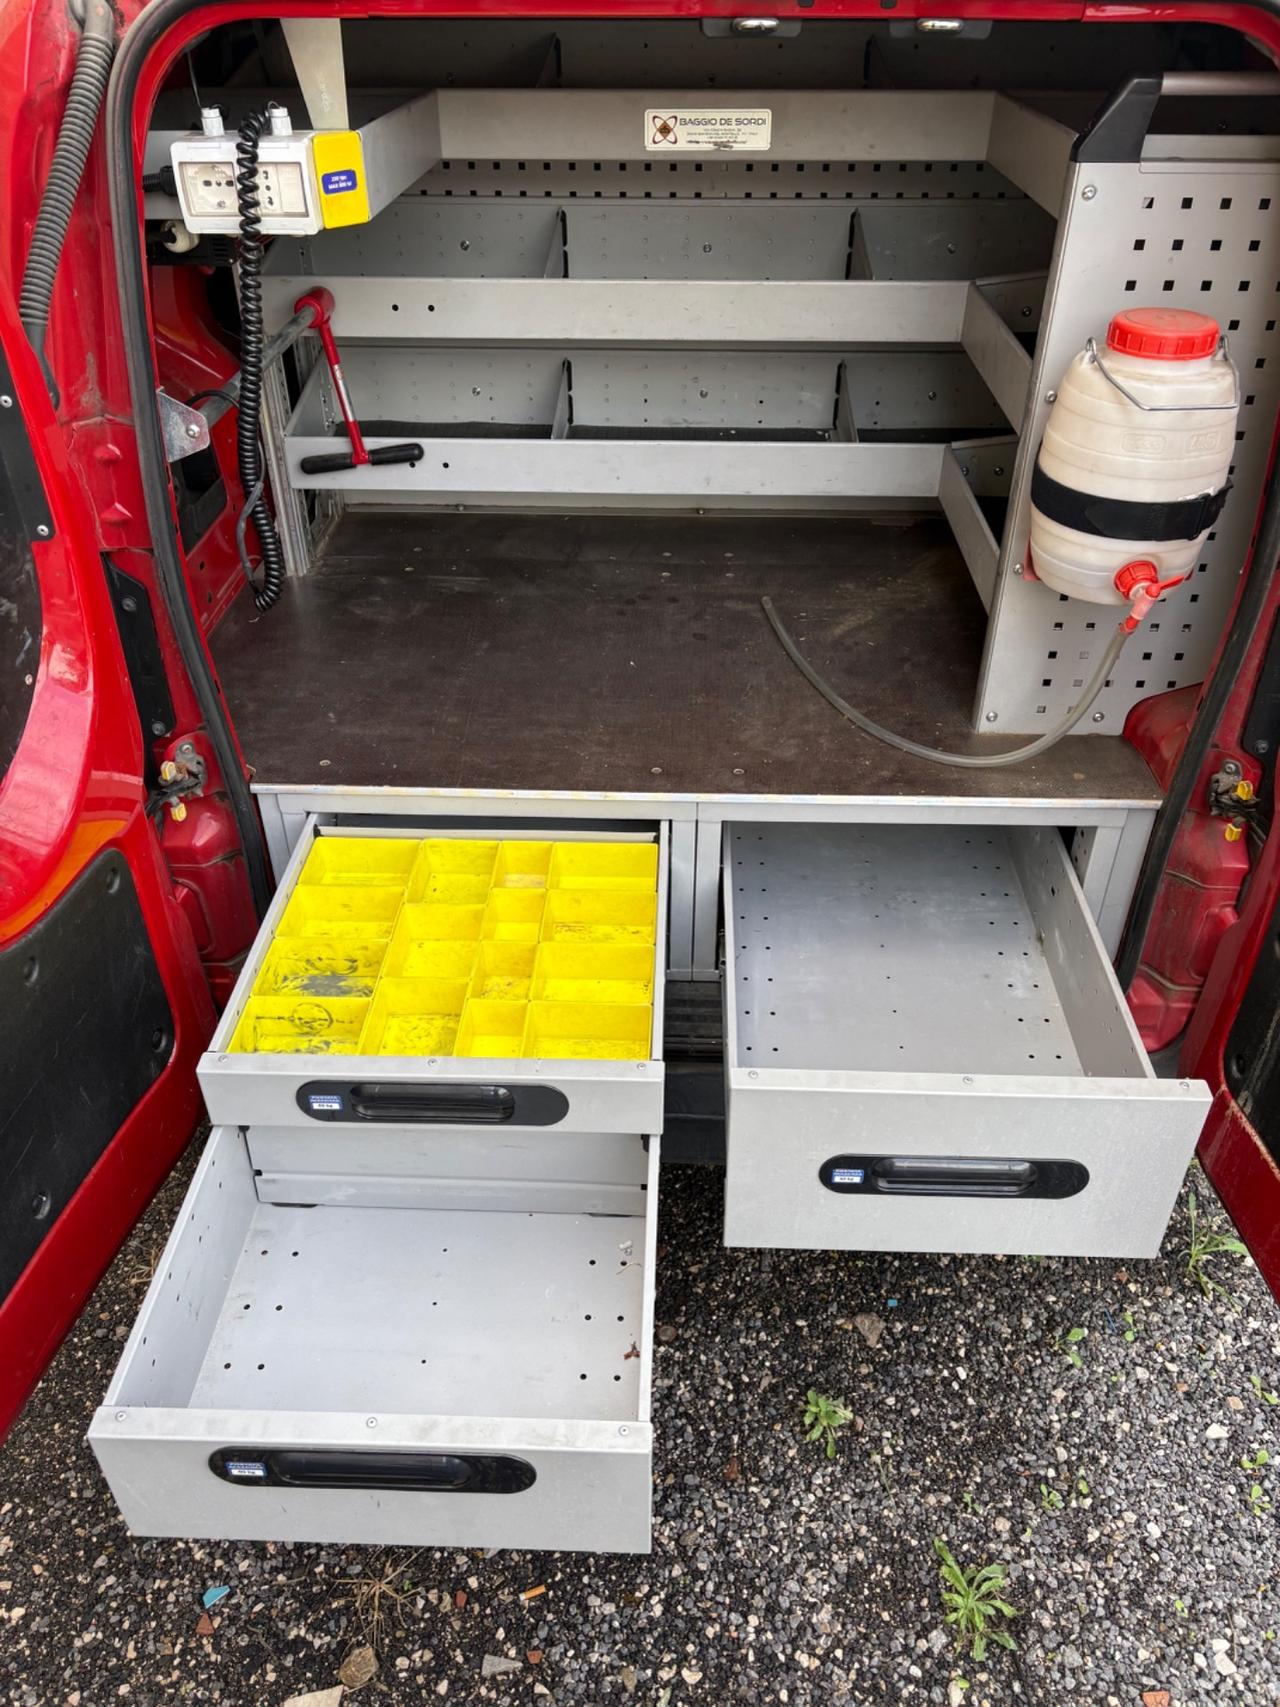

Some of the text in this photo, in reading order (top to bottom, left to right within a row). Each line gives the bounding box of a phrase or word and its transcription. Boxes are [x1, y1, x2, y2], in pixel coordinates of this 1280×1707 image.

[679, 117, 767, 126] BAGGIO DE SORDI
